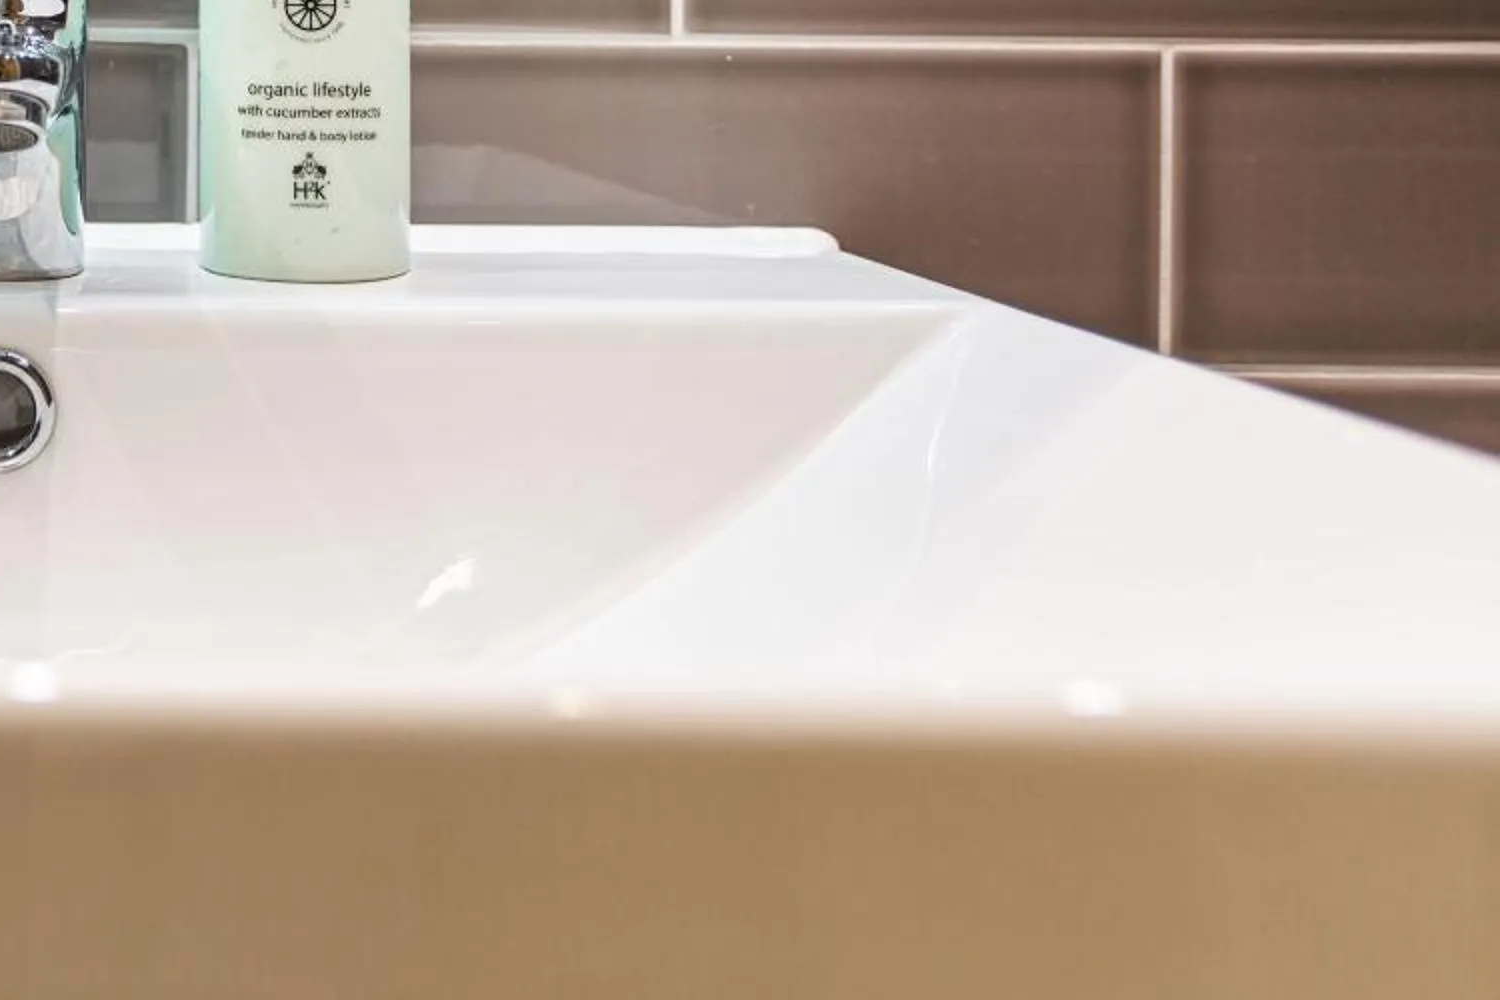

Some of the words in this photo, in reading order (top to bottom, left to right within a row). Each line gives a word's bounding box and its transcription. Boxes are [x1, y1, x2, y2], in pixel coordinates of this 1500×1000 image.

[247, 82, 308, 100] organic
[313, 81, 372, 100] lifestyle
[237, 104, 263, 117] with
[265, 106, 332, 119] cucumber
[336, 106, 381, 119] extracts
[277, 130, 306, 141] hand
[308, 131, 317, 141] &
[320, 130, 347, 144] body
